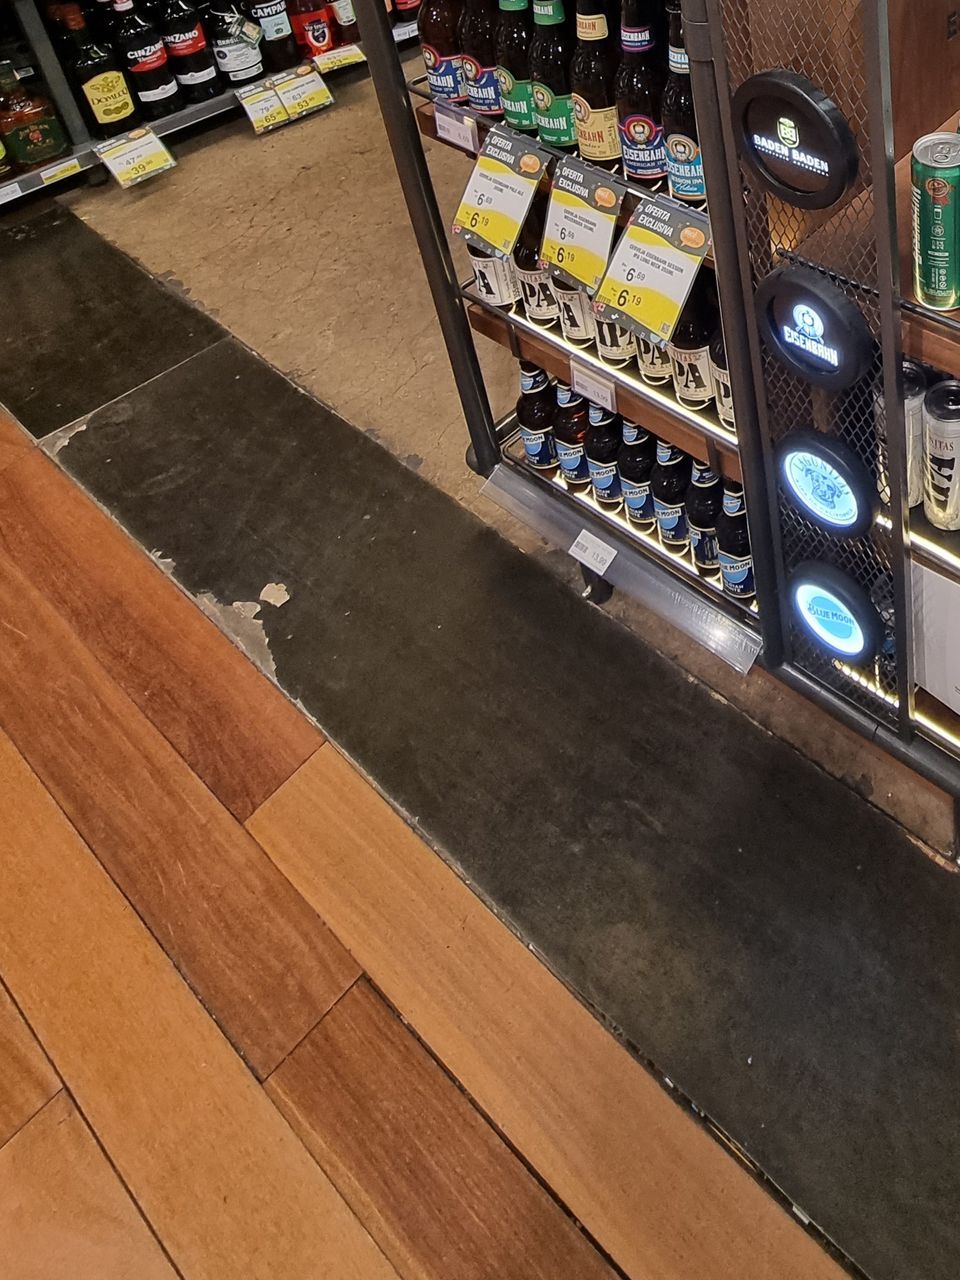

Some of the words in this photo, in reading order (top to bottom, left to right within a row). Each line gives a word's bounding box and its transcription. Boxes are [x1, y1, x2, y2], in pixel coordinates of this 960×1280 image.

[491, 135, 513, 152] OFERTA
[486, 145, 516, 165] EXCLUSIVA
[754, 134, 789, 158] BADEN
[792, 148, 829, 174] BADEN
[562, 167, 584, 183] OFERTA
[558, 178, 589, 198] EXCLUSIVA
[644, 204, 671, 222] OFERTA
[638, 214, 674, 237] EXCLUSIVA
[784, 325, 839, 367] EISENBAHN
[807, 603, 831, 620] BLUE
